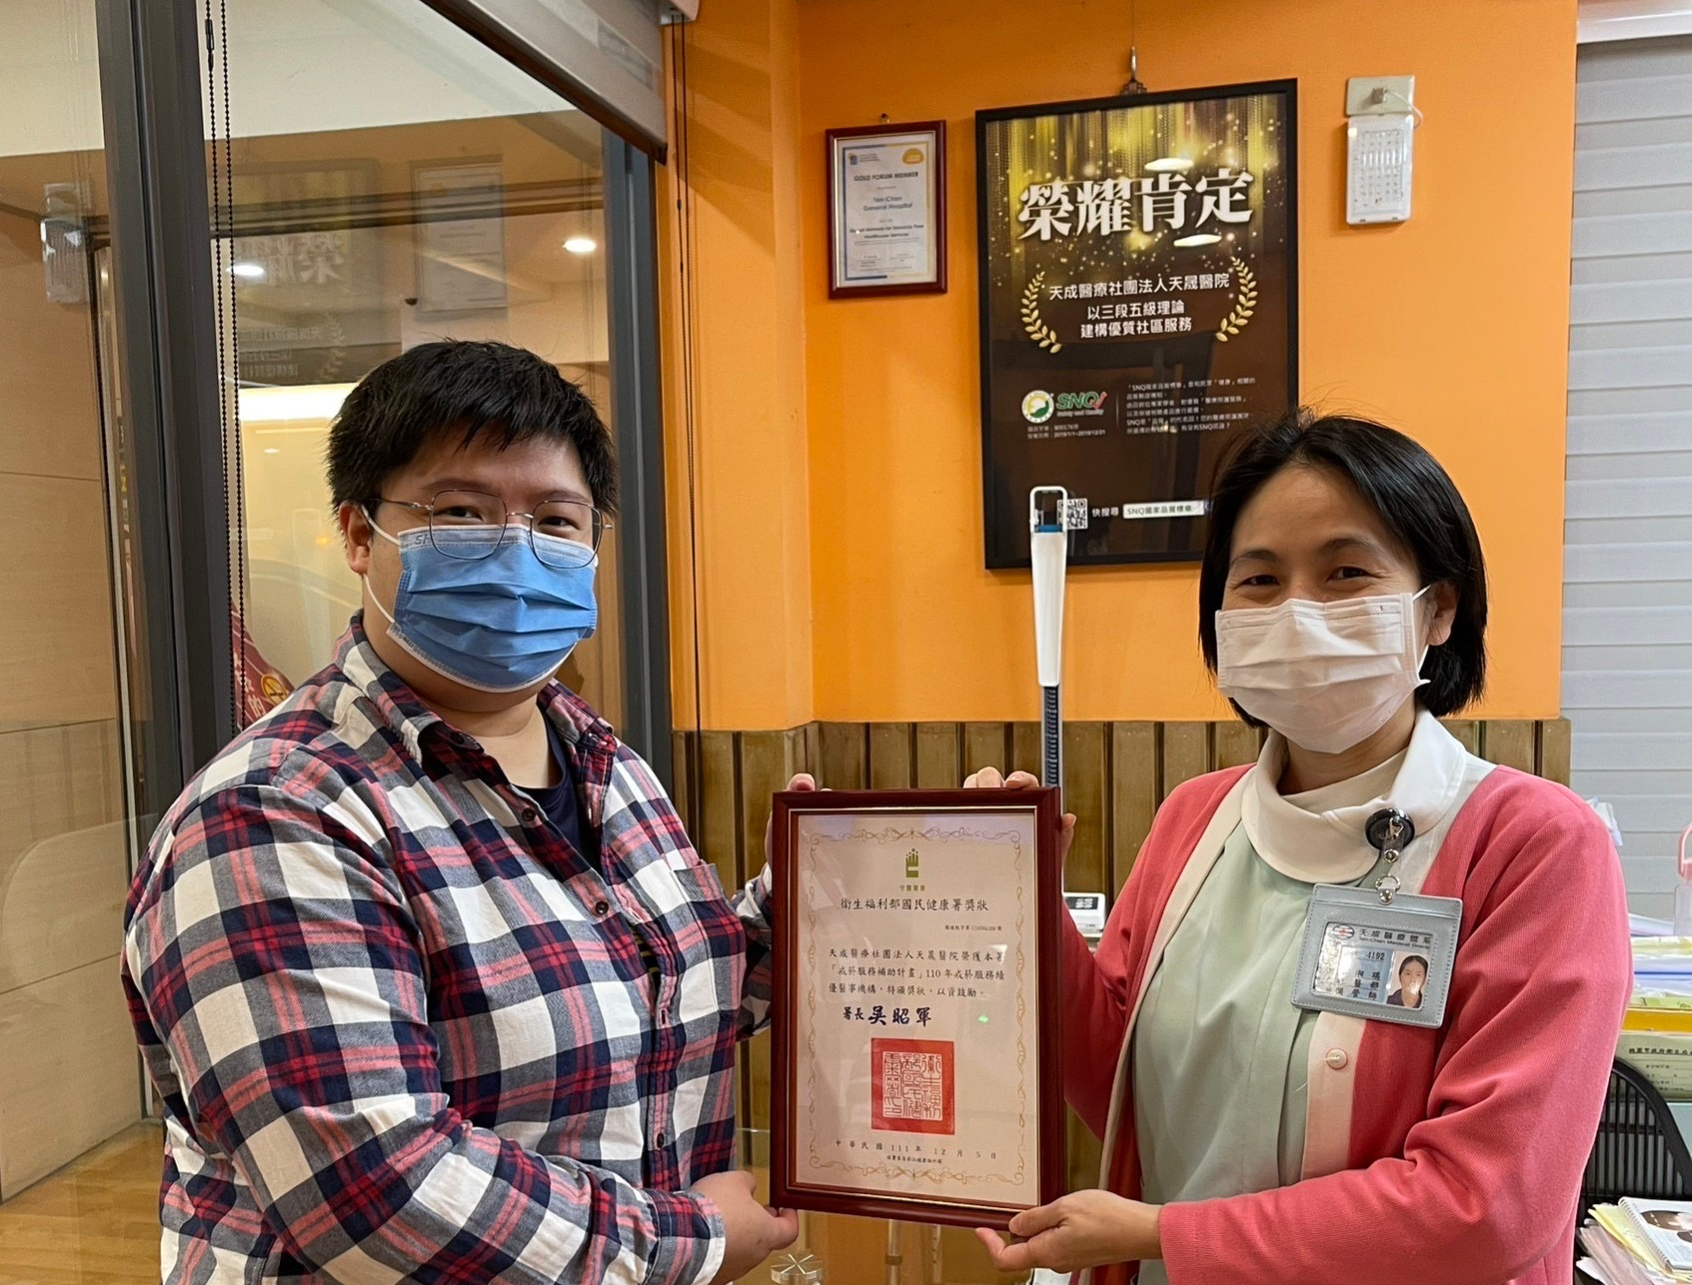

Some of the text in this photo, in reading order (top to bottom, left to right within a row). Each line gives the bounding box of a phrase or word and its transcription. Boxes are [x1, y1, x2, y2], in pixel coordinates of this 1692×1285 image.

[1018, 167, 1253, 241] 榮耀肯定
[1049, 272, 1230, 301] 天成醫療社團法人天晟醫院
[1087, 299, 1185, 321] 以三段五級理論
[1080, 317, 1192, 339] 建構優質社區服務
[840, 898, 989, 911] 衛生福利部國民健康署獎狀
[1366, 951, 1385, 960] 4192
[843, 1006, 865, 1020] 署長
